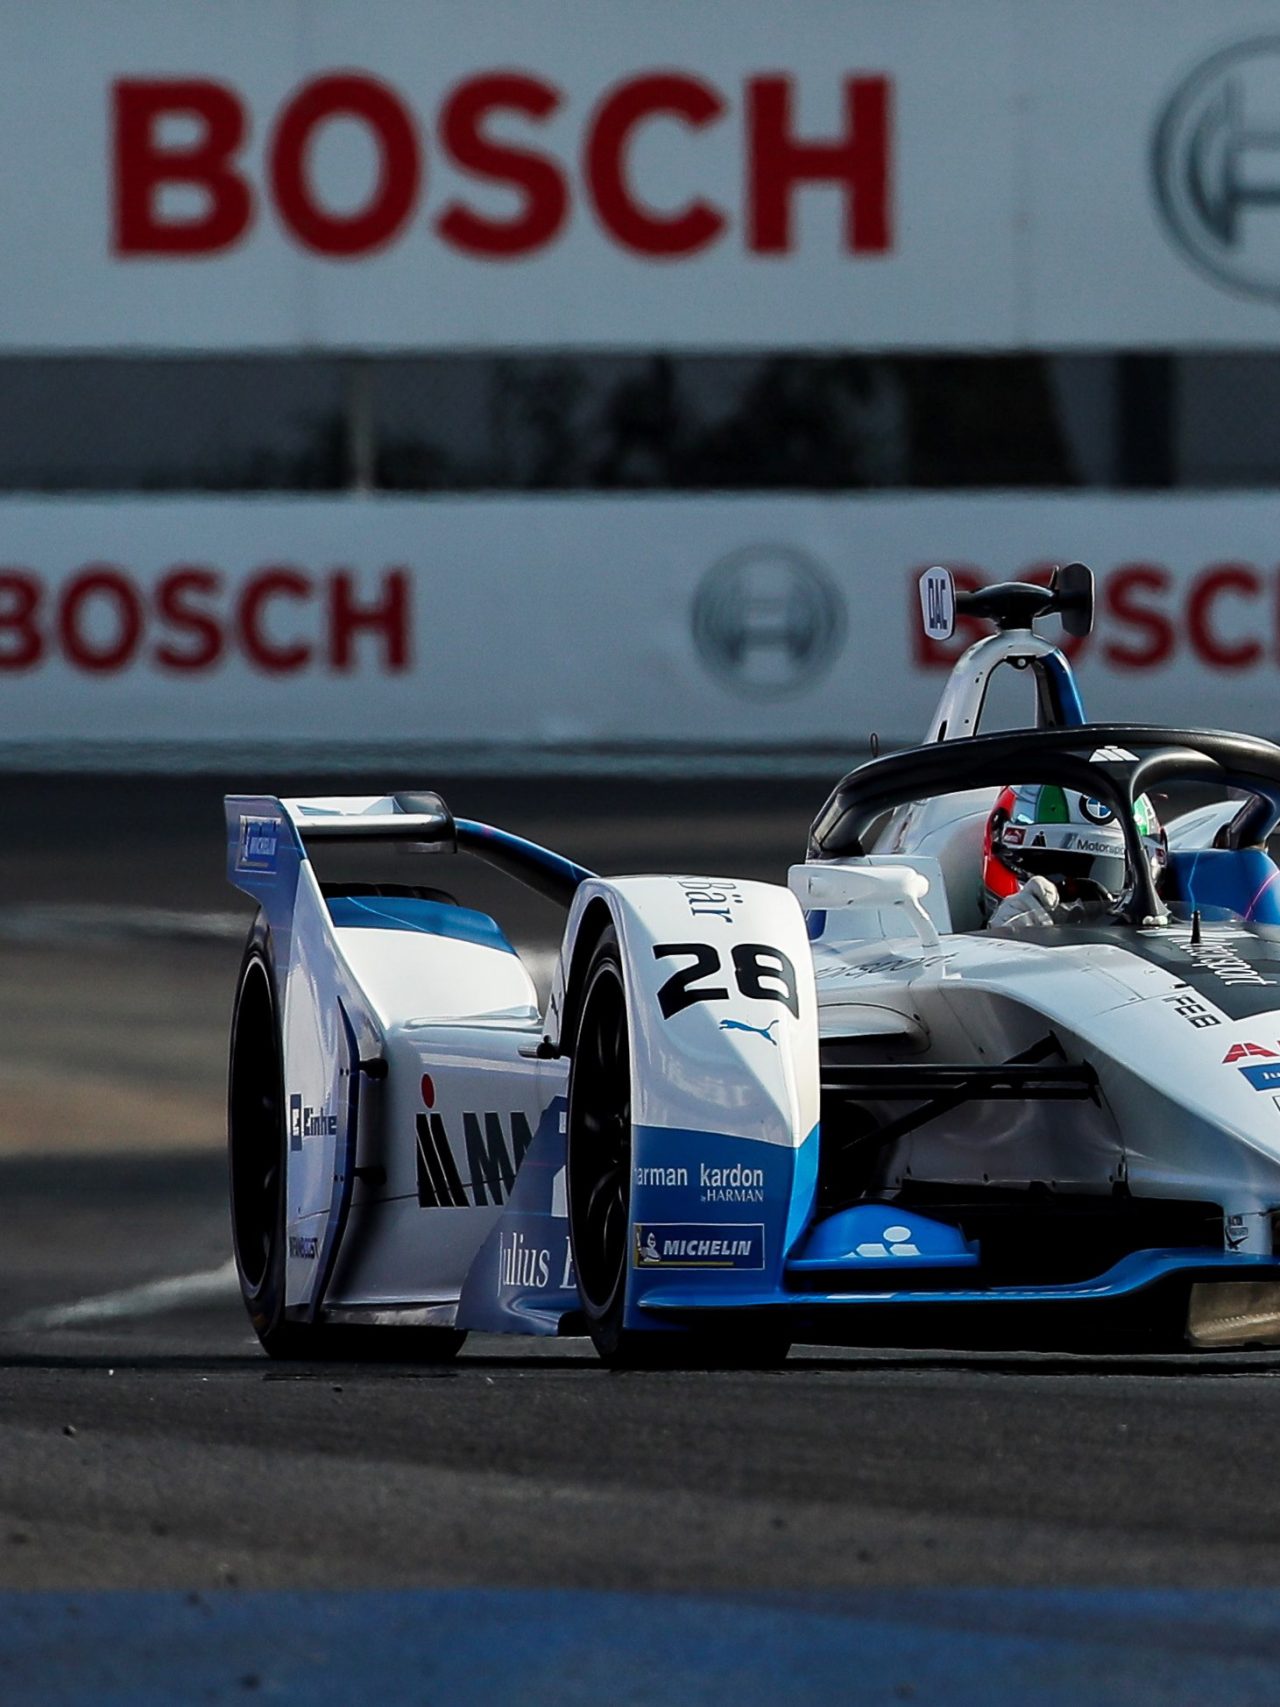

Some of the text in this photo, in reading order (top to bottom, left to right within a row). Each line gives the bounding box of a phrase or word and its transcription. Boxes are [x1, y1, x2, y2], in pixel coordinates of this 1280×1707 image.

[111, 70, 894, 261] BOSCH
[677, 881, 743, 923] Bär
[652, 942, 800, 1020] 28
[634, 1163, 764, 1187] arman kardon
[707, 1189, 764, 1202] HARMAN
[663, 1240, 752, 1256] MICHELIN
